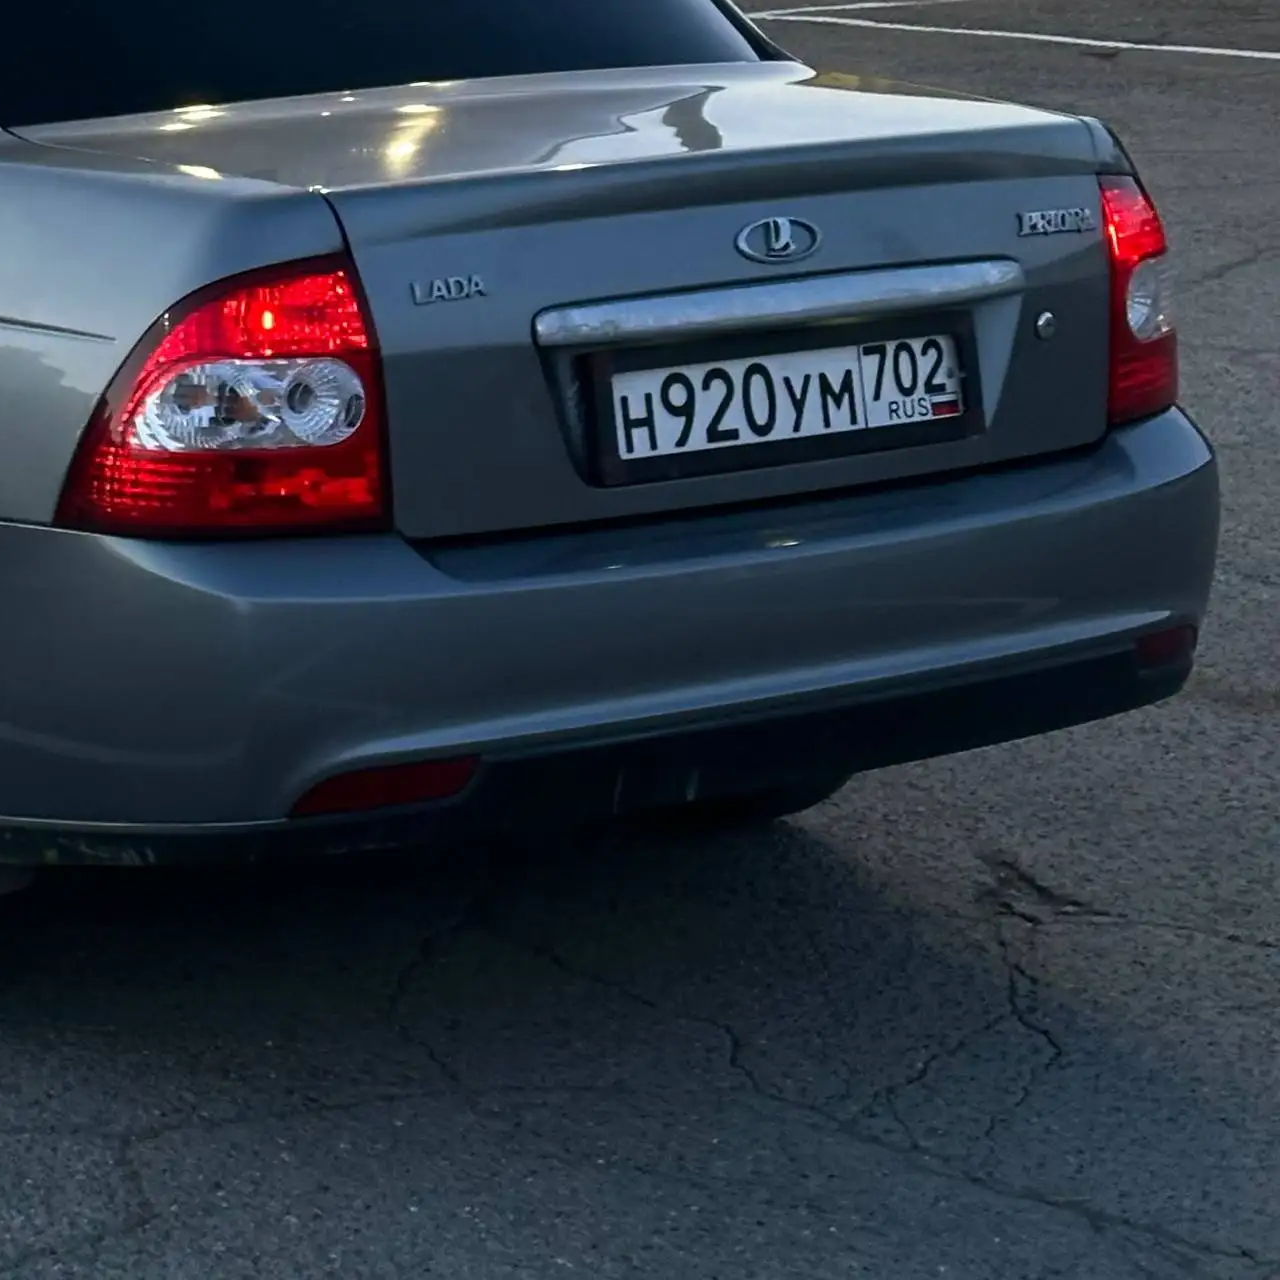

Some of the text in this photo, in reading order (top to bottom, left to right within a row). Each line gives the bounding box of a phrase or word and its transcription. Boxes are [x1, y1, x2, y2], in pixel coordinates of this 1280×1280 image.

[410, 274, 487, 306] LADA
[862, 338, 947, 402] 702
[888, 399, 930, 421] RUS
